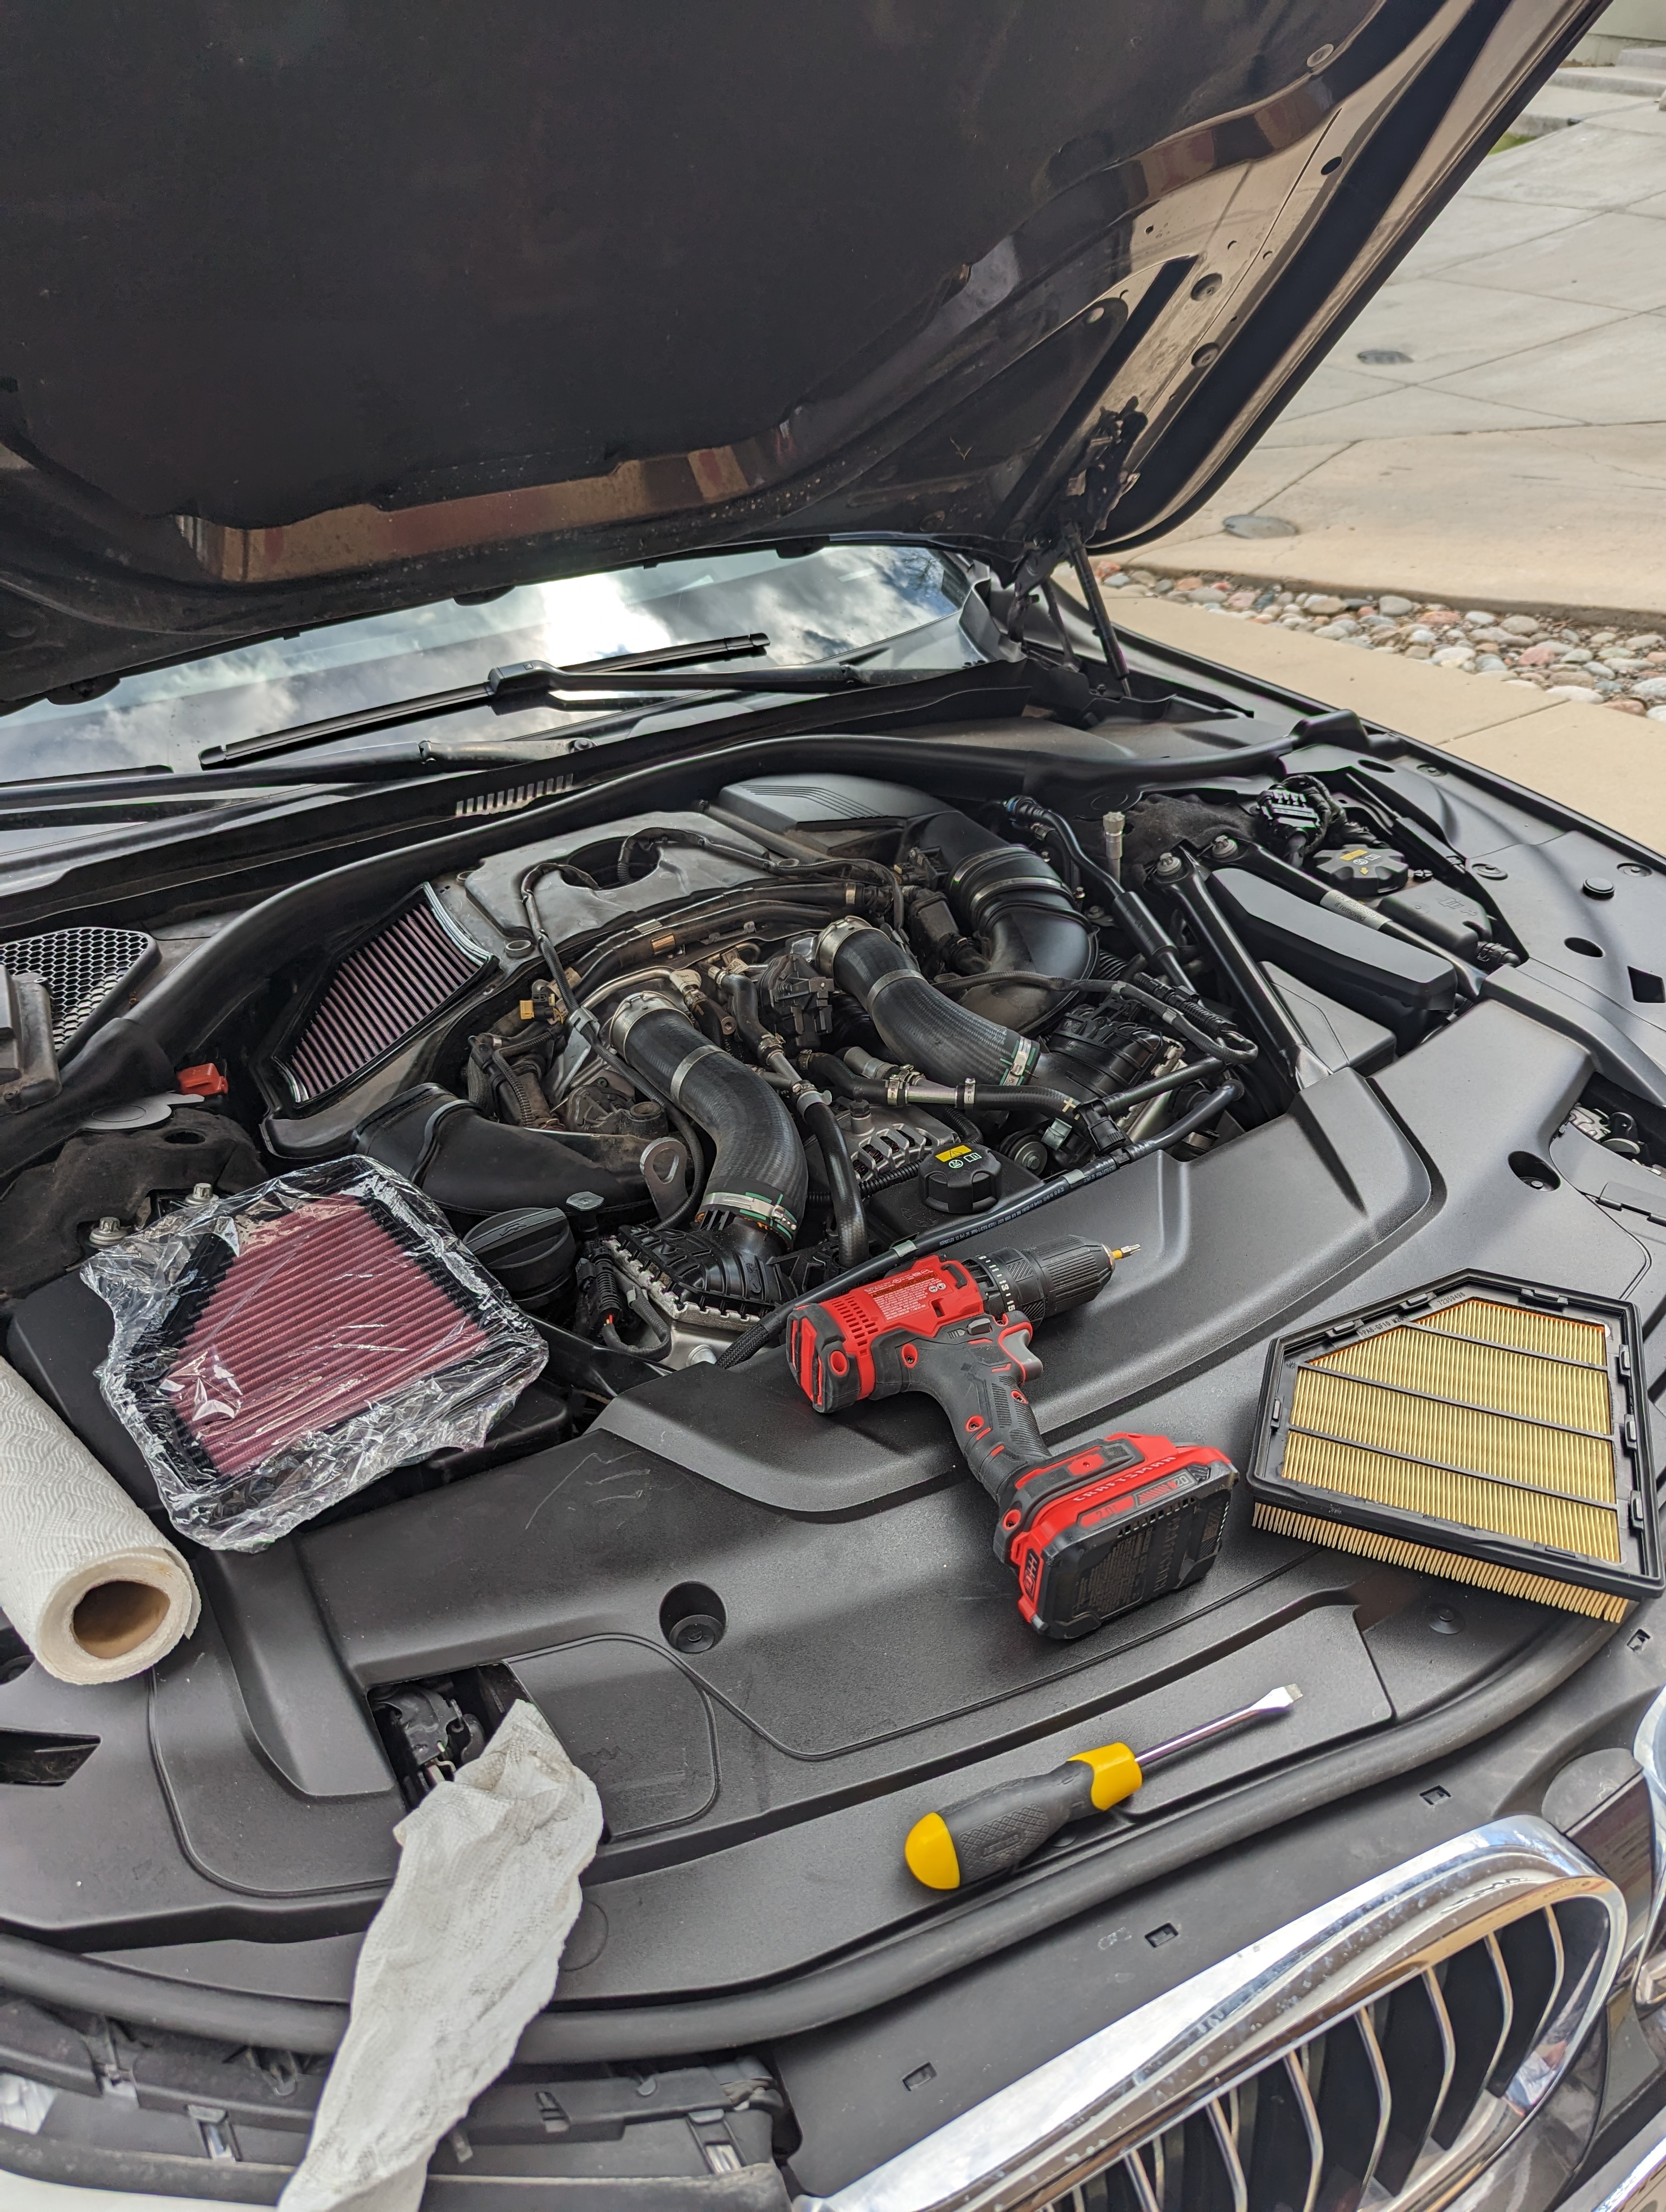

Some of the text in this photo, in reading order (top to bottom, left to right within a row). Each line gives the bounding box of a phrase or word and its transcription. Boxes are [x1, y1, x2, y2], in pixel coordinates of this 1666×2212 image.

[1339, 905, 1366, 922] removed
[989, 1264, 999, 1272] 11
[999, 1279, 1010, 1291] 13
[1007, 1300, 1016, 1312] 15
[1437, 1291, 1465, 1306] 72359498
[1073, 1456, 1176, 1502] CRAFTSMAN
